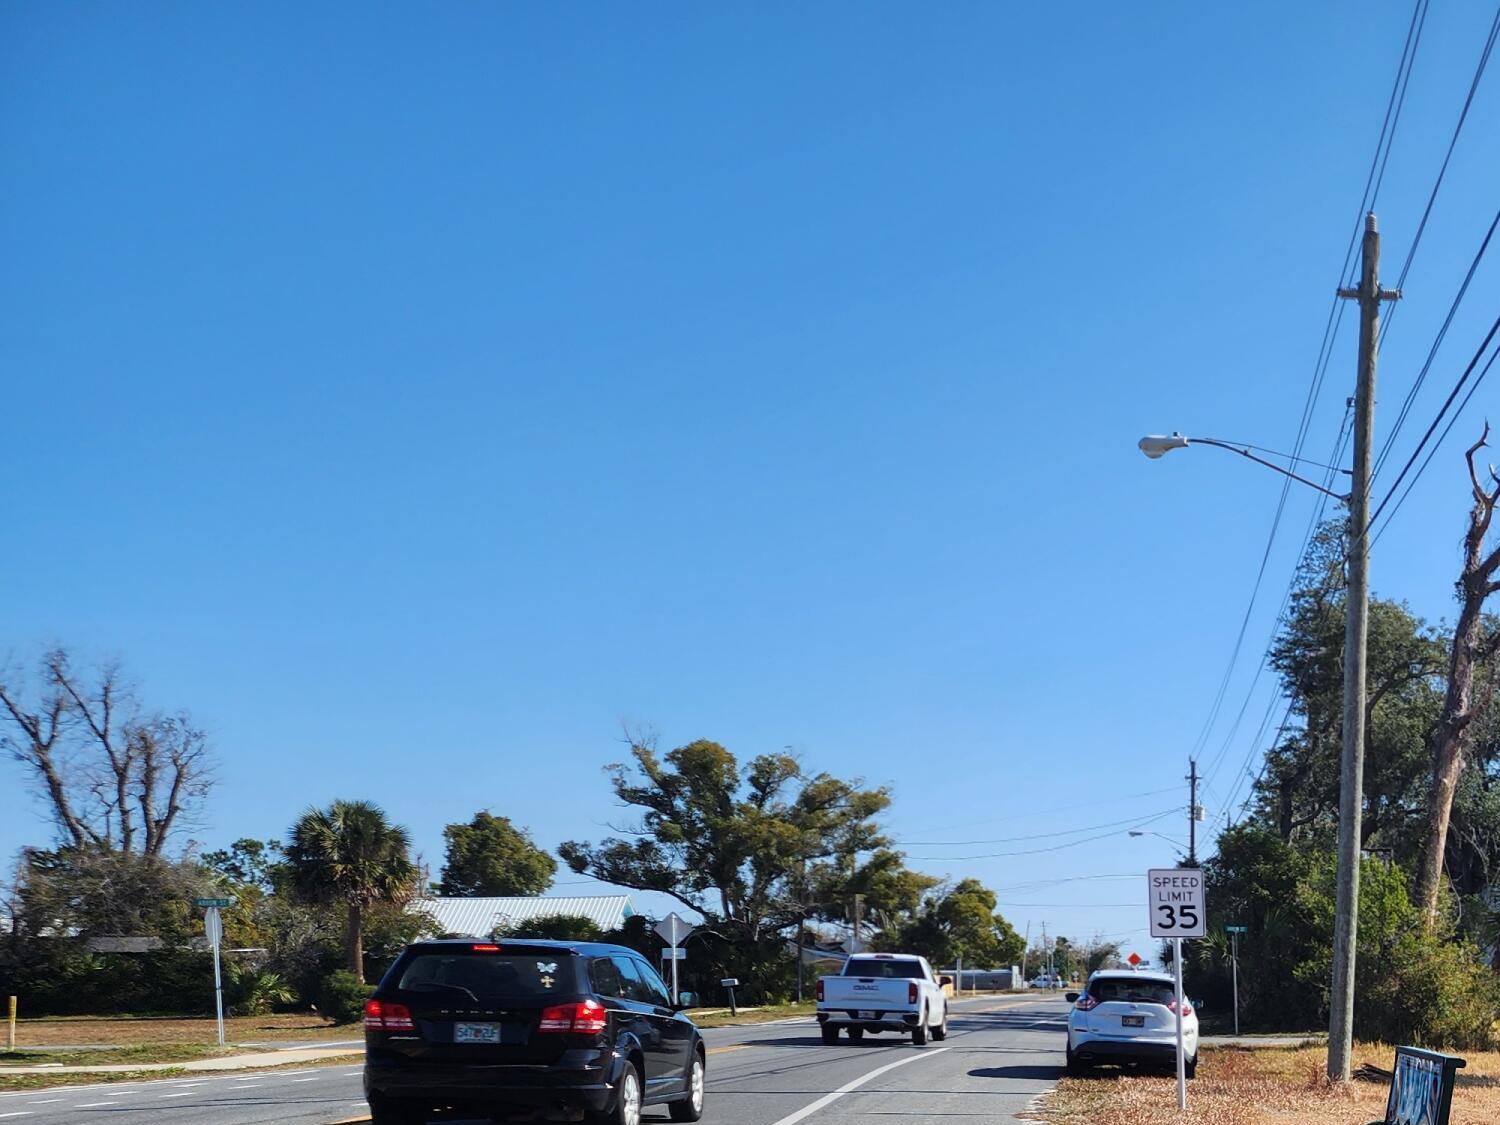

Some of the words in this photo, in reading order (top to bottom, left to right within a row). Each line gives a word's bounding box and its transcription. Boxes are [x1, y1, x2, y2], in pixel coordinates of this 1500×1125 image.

[1153, 877, 1199, 888] SPEED
[1158, 891, 1194, 902] LIMIT
[1157, 904, 1199, 930] 35
